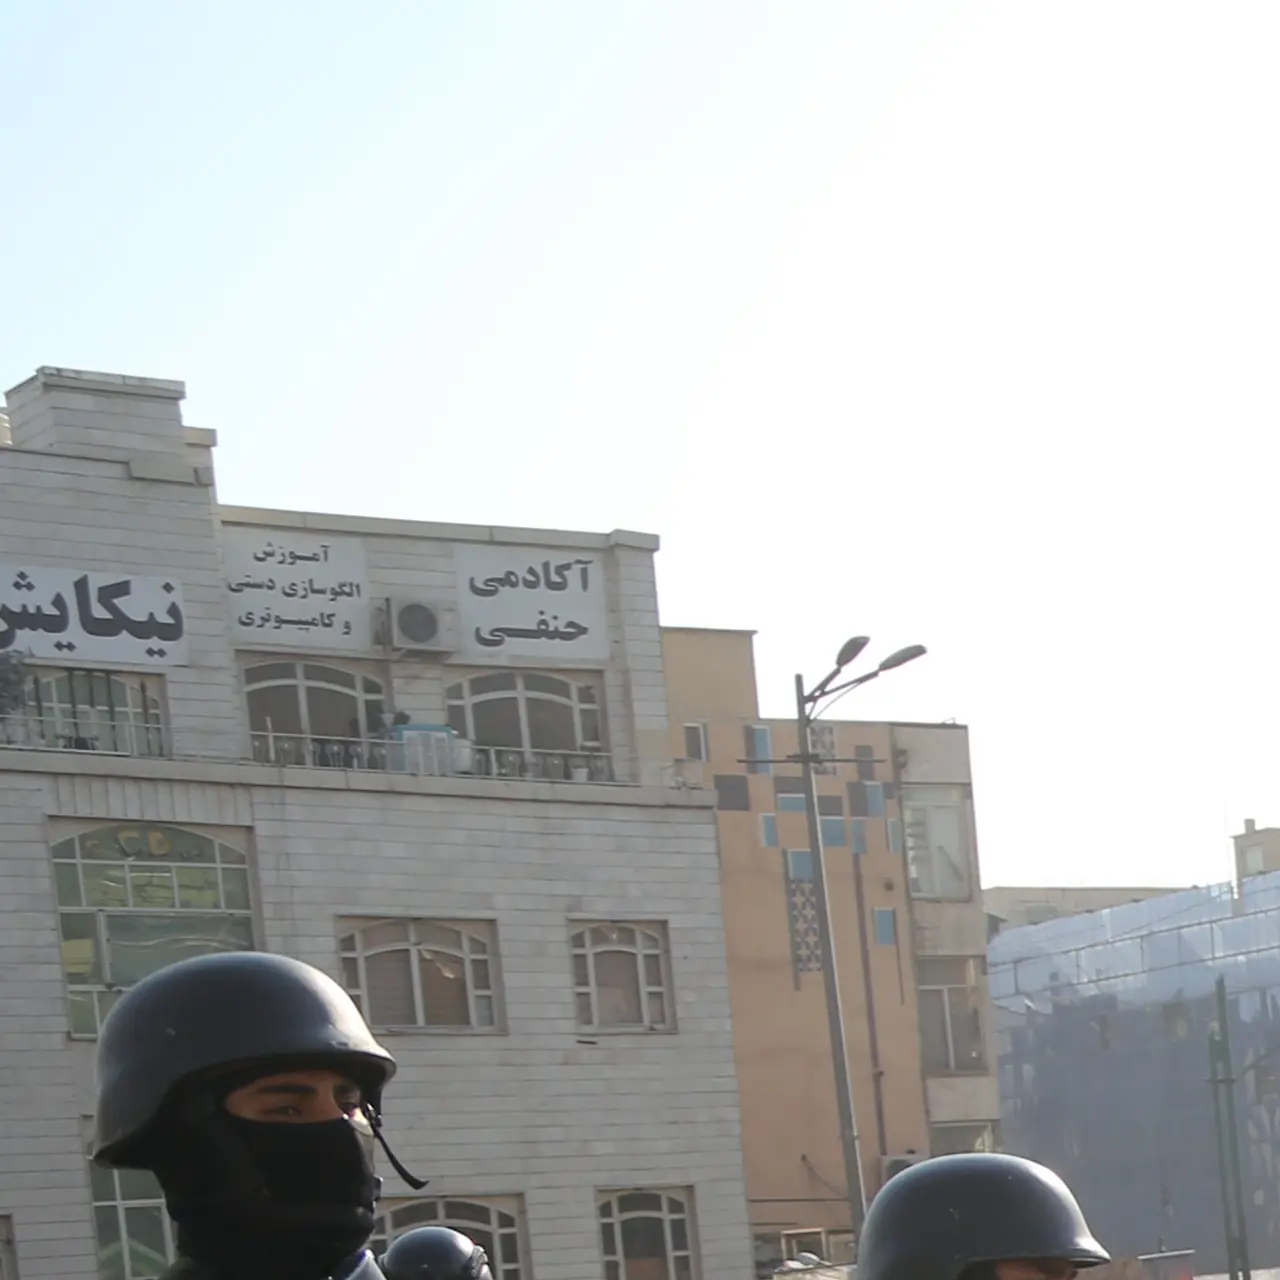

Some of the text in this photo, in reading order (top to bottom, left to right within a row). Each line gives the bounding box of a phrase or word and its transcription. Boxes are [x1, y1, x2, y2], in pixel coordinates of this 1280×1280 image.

[253, 541, 331, 566] آموزش
[227, 574, 276, 593] دستی
[469, 557, 594, 598] آکادمی
[238, 606, 352, 635] و کامپیوتری
[475, 613, 589, 648] حنفی
